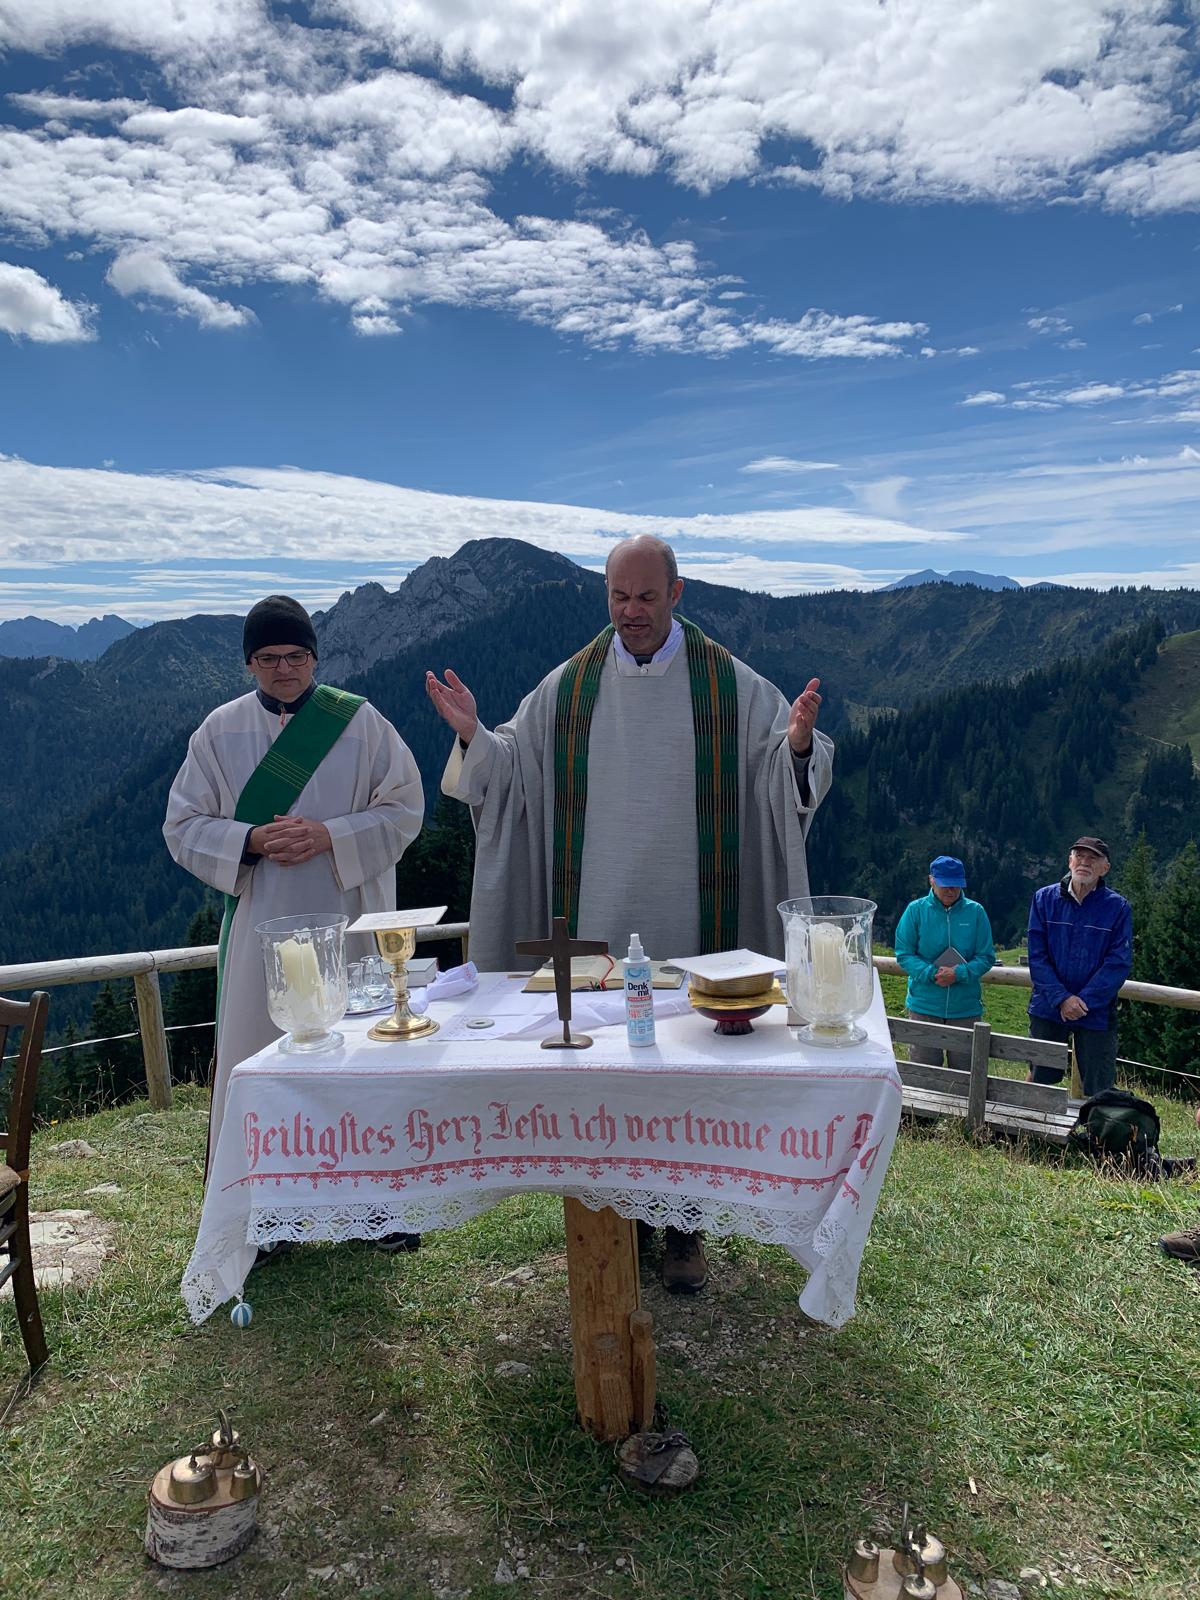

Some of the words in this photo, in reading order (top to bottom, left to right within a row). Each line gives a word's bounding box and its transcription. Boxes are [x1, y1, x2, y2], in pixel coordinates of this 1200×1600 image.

[627, 982, 649, 991] Denk
[402, 1108, 482, 1163] Herz
[568, 1103, 618, 1150] ich
[624, 1107, 773, 1153] vertraue
[777, 1114, 846, 1169] auf
